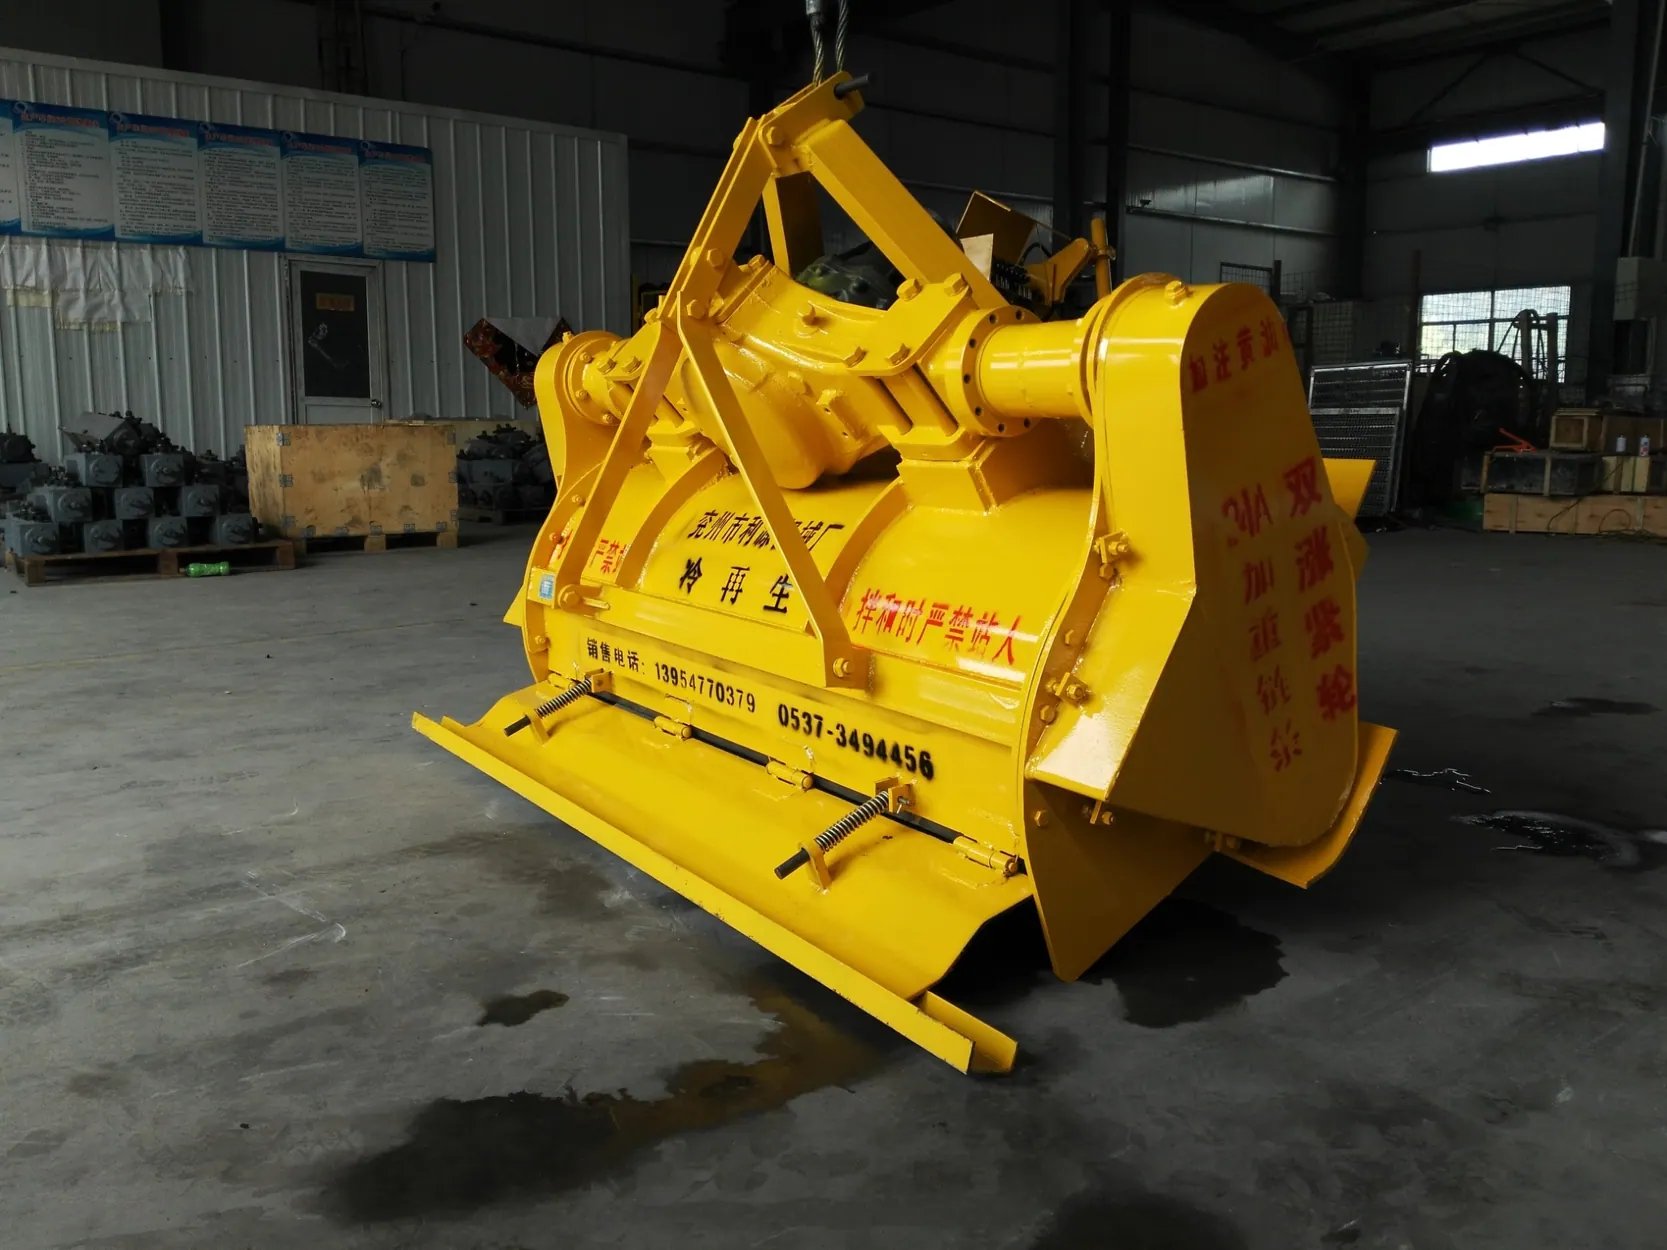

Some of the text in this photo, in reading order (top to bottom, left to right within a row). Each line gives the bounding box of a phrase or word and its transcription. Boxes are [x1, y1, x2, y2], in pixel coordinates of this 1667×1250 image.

[687, 509, 845, 552] 兖州市利源械厂
[852, 587, 1022, 666] 拌和时严禁站人
[655, 662, 756, 713] 13954770379
[778, 703, 935, 781] 0537-3494456
